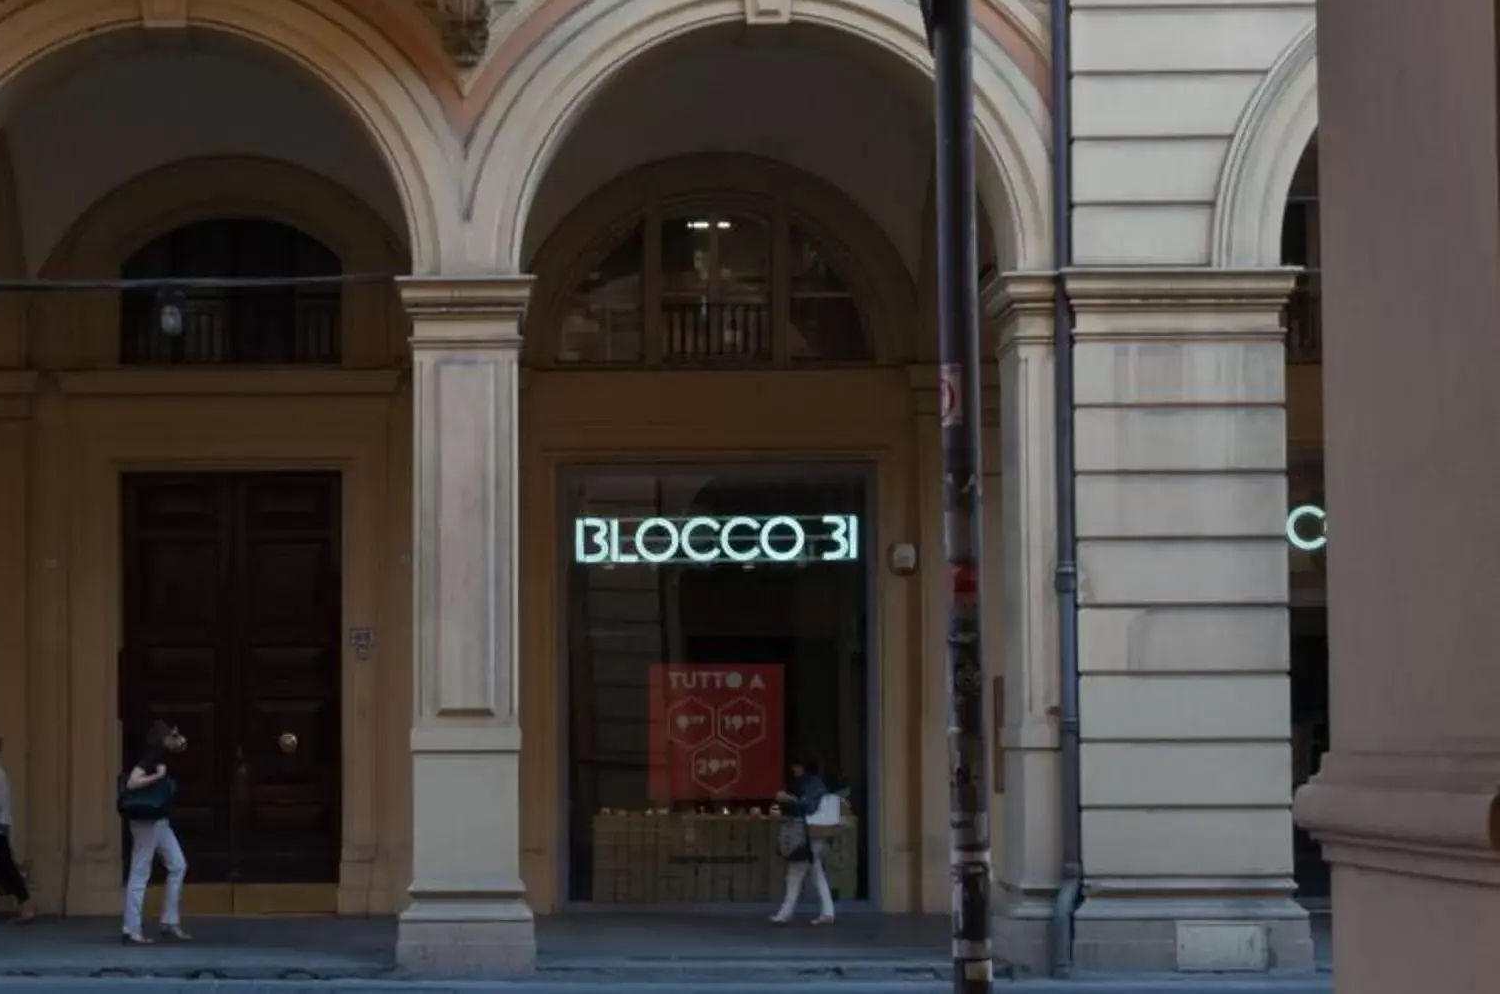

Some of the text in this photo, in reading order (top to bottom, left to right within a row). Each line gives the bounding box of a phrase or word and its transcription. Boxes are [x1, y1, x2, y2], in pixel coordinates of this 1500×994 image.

[575, 515, 858, 563] BLOCCO 31
[1285, 505, 1328, 550] C
[668, 671, 765, 689] TUTTO A
